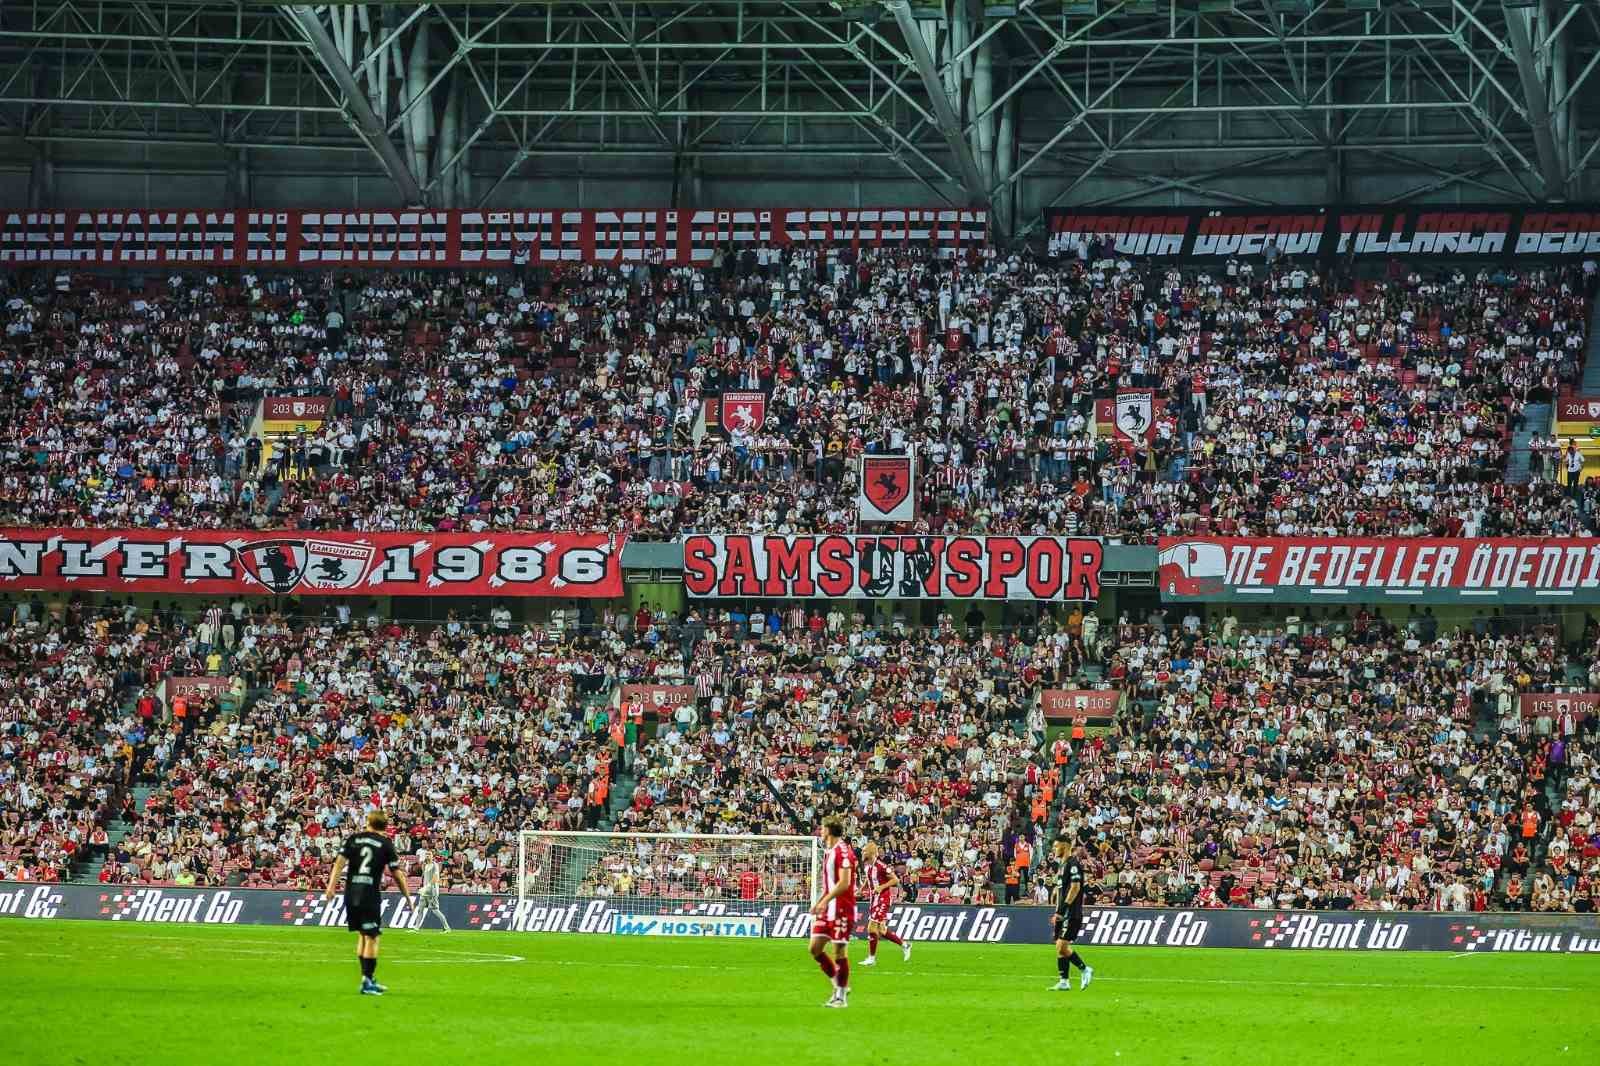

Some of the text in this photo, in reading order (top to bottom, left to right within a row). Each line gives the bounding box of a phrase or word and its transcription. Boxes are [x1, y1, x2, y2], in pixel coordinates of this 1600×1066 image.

[299, 212, 448, 261] SENDEN
[272, 404, 325, 414] 203 204
[1566, 404, 1585, 415] 206
[310, 543, 369, 558] SAMSUNSPOR
[383, 544, 608, 583] 1986
[684, 535, 1103, 600] SAMSUNSPOR
[1225, 545, 1274, 586] NE
[1278, 545, 1459, 588] BEDELLER
[1051, 697, 1112, 709] 104 105
[1573, 700, 1593, 712] 106
[358, 846, 374, 875] 2
[136, 889, 244, 923] Rent Go
[507, 898, 618, 934] Rent Go
[772, 903, 812, 938] Go
[662, 922, 760, 937] HOSPITAL
[895, 907, 1009, 942] Rent Go
[1090, 910, 1208, 946] Rent Go
[1290, 914, 1366, 948] Rent
